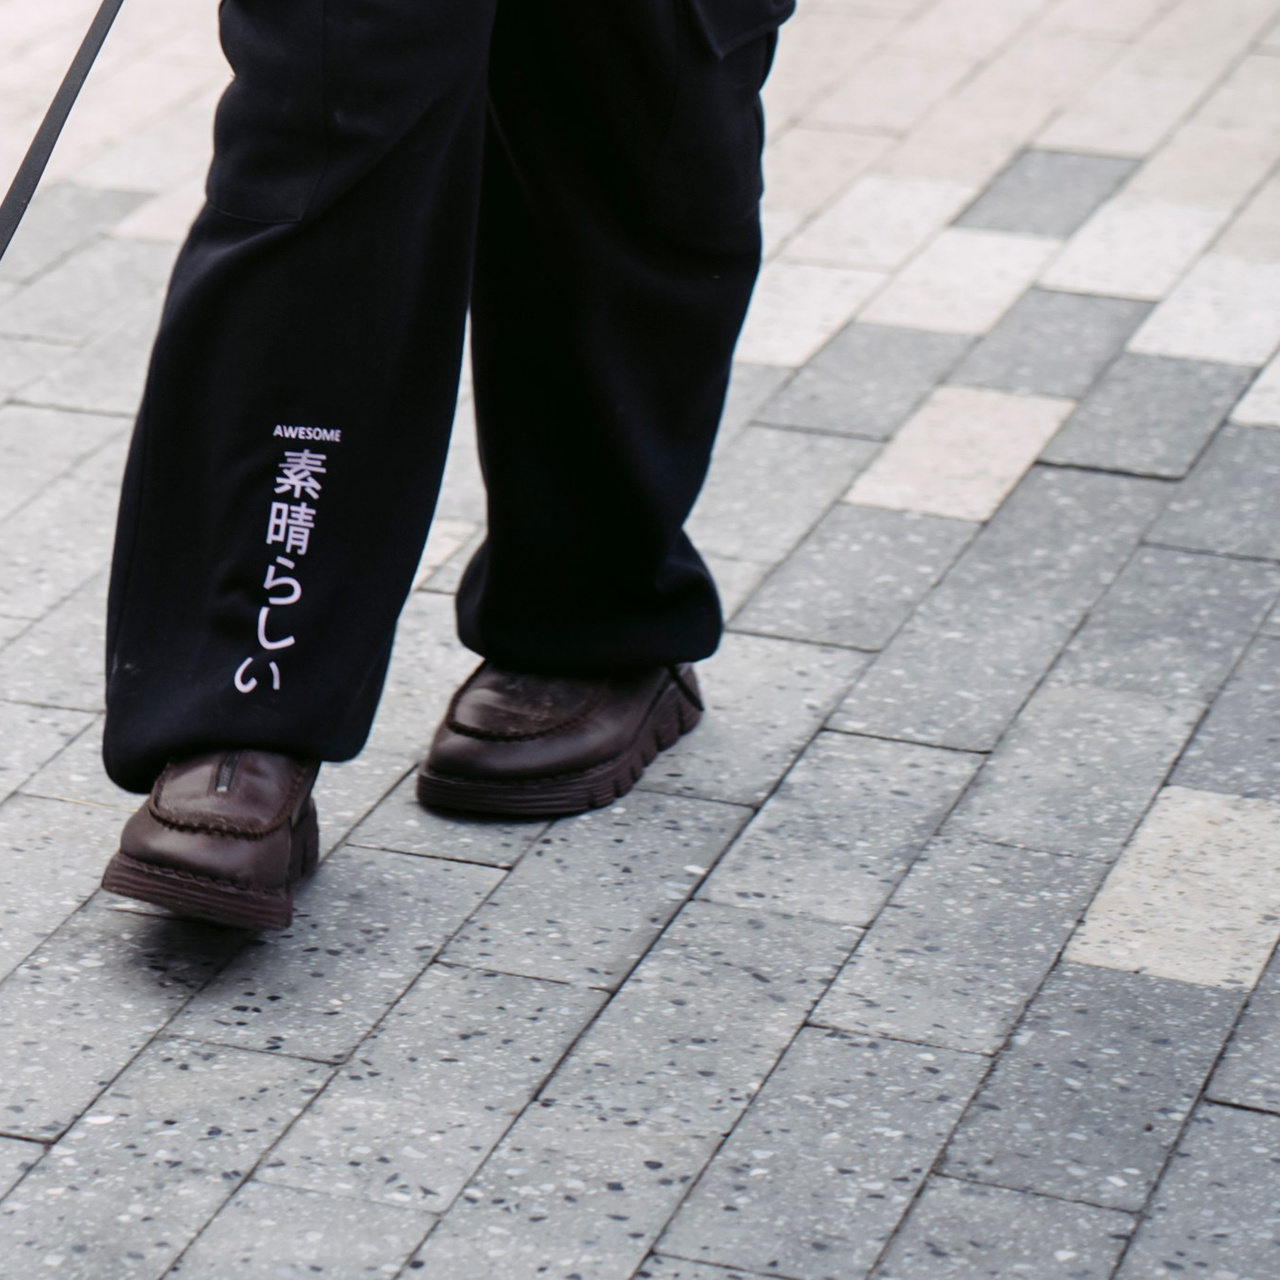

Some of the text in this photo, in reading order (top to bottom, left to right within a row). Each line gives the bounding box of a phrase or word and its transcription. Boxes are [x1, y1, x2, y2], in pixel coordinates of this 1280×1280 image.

[272, 424, 342, 442] AWESOME
[234, 448, 328, 694] 素晴らしい
